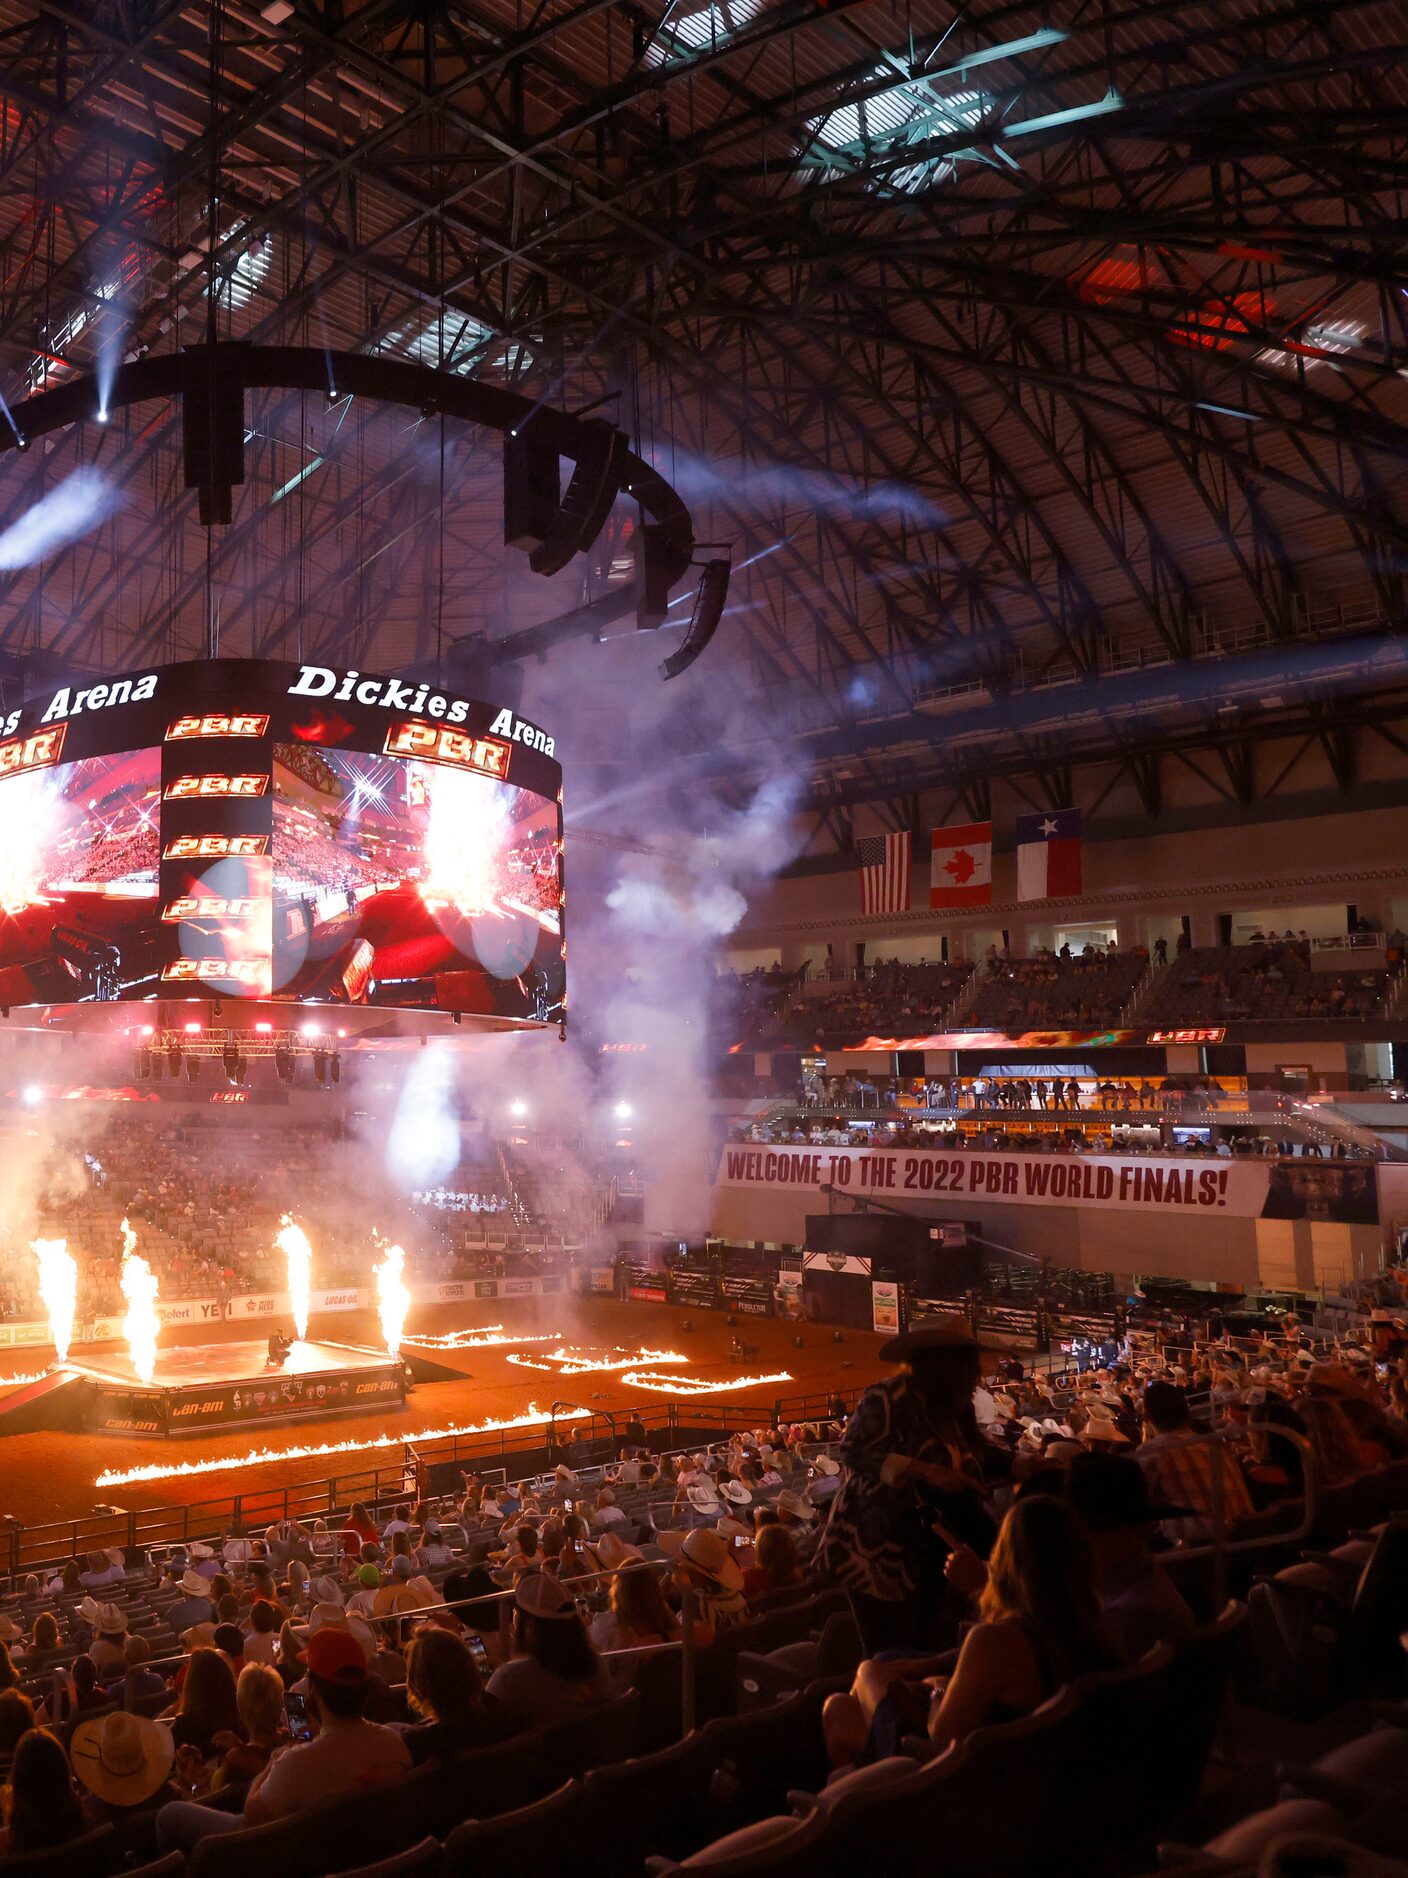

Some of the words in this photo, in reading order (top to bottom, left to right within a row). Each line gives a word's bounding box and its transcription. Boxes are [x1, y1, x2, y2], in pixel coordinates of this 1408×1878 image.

[40, 674, 159, 724] Arena
[287, 665, 470, 722] Dickies
[489, 708, 557, 758] Arena
[172, 717, 262, 737] PBR
[396, 724, 504, 772] PBR
[171, 777, 261, 796] PBR
[170, 837, 260, 856] PBR
[169, 898, 257, 916] PBR
[168, 960, 258, 977] PBR
[727, 1151, 822, 1185] WELCOME
[827, 1154, 852, 1186] TO
[859, 1156, 896, 1188] THE
[904, 1158, 965, 1192] 2022
[969, 1161, 1019, 1195] PBR
[1024, 1162, 1113, 1201] WORLD
[1118, 1165, 1229, 1207] FINALS!
[324, 1295, 346, 1305] LUCAS
[738, 1301, 766, 1313] PENDLETON
[201, 1303, 232, 1318] YEI
[105, 1418, 158, 1431] can-am
